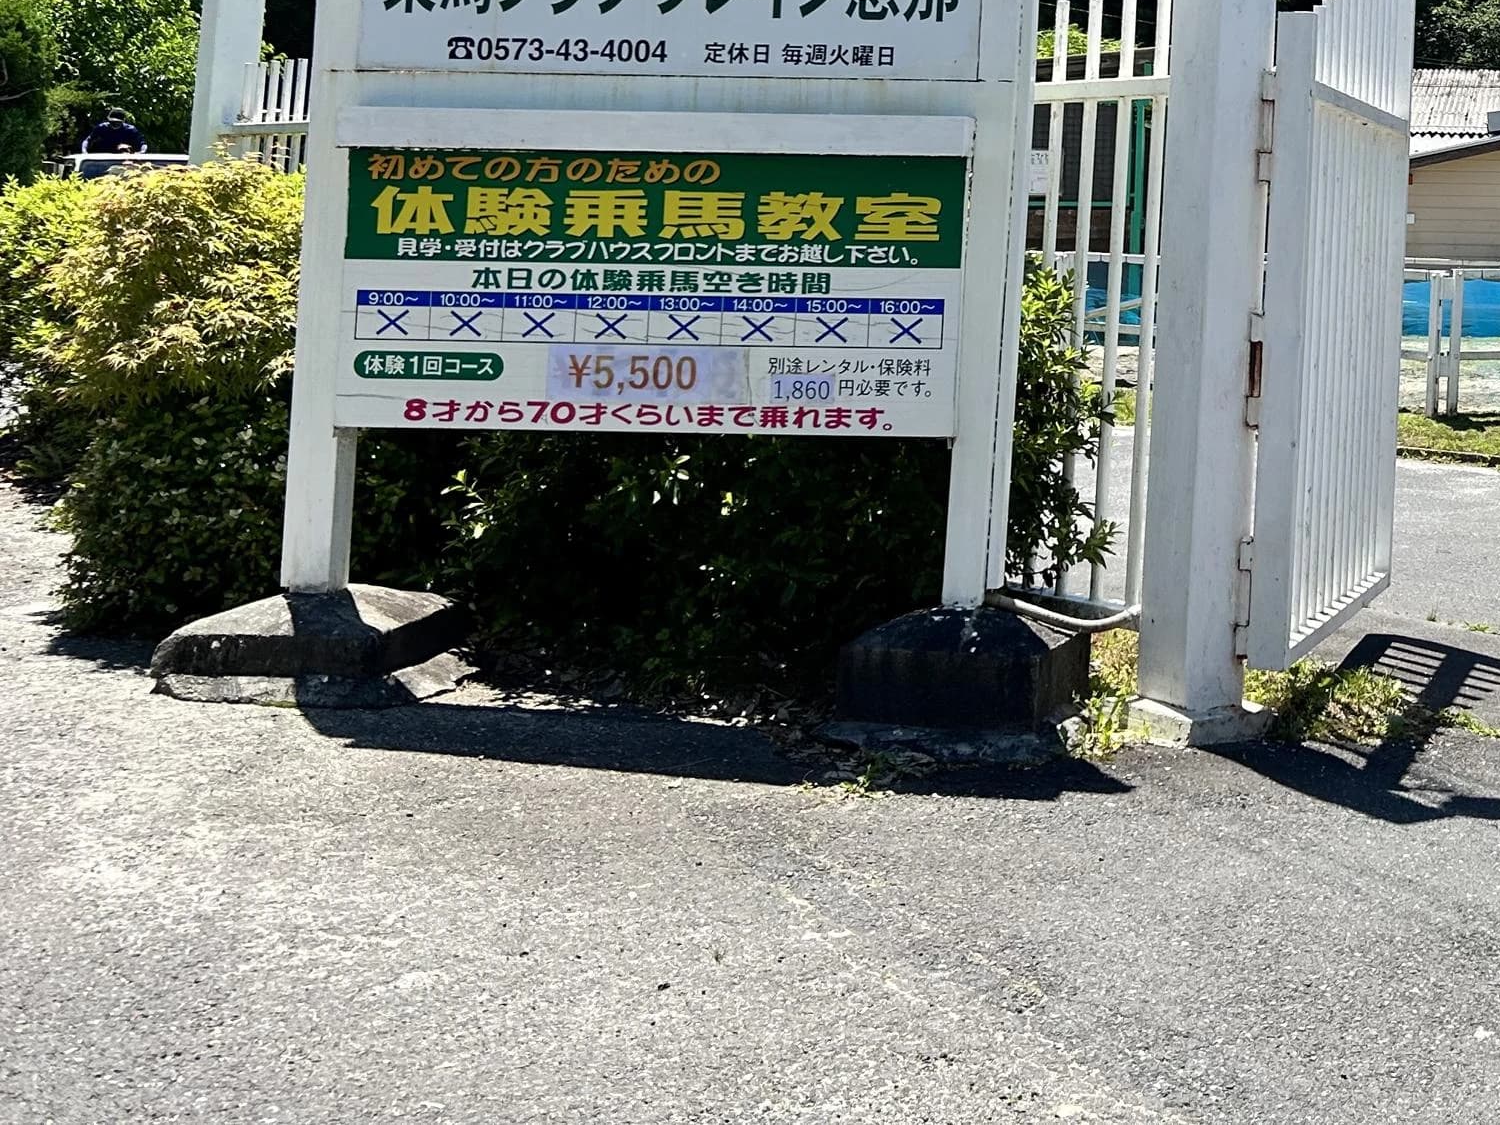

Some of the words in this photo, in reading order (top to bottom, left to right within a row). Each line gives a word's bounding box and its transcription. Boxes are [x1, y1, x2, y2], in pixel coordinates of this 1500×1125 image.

[477, 37, 668, 63] 0573-43-4004
[704, 42, 770, 64] 定休日
[782, 43, 895, 67] 毎週火曜日
[368, 154, 721, 185] 初めての方のための
[370, 185, 942, 242] 体験乗馬教室
[471, 267, 831, 295] 本日の体験乗馬空き時間
[363, 355, 495, 376] 体験1回コース
[569, 354, 697, 394] ¥5,500
[768, 357, 931, 377] 別途レンタル・保険料
[404, 399, 892, 431] 8才から70才くらいまで乗れます。
